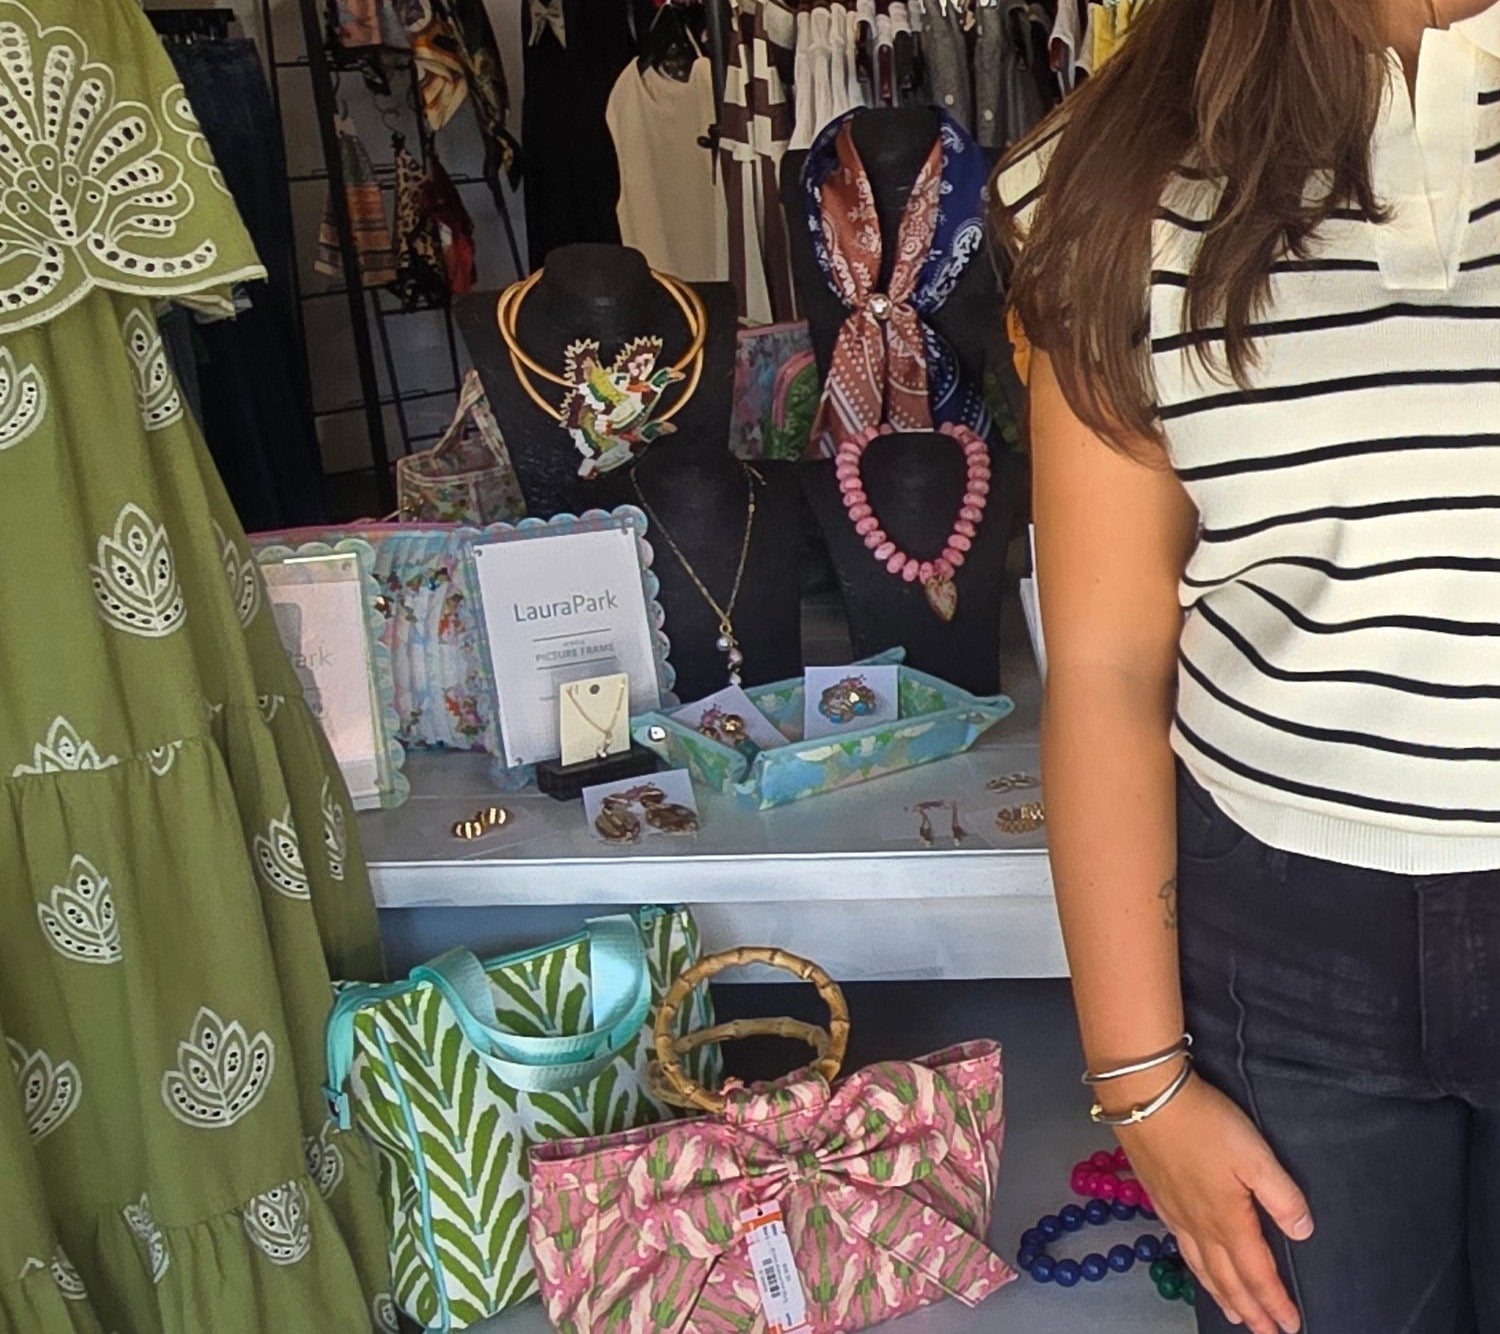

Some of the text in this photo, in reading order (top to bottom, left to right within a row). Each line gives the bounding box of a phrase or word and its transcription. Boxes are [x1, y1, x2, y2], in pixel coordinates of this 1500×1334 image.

[513, 589, 619, 622] LauraPark
[535, 648, 578, 662] PICTURE
[580, 643, 616, 656] FRAME
